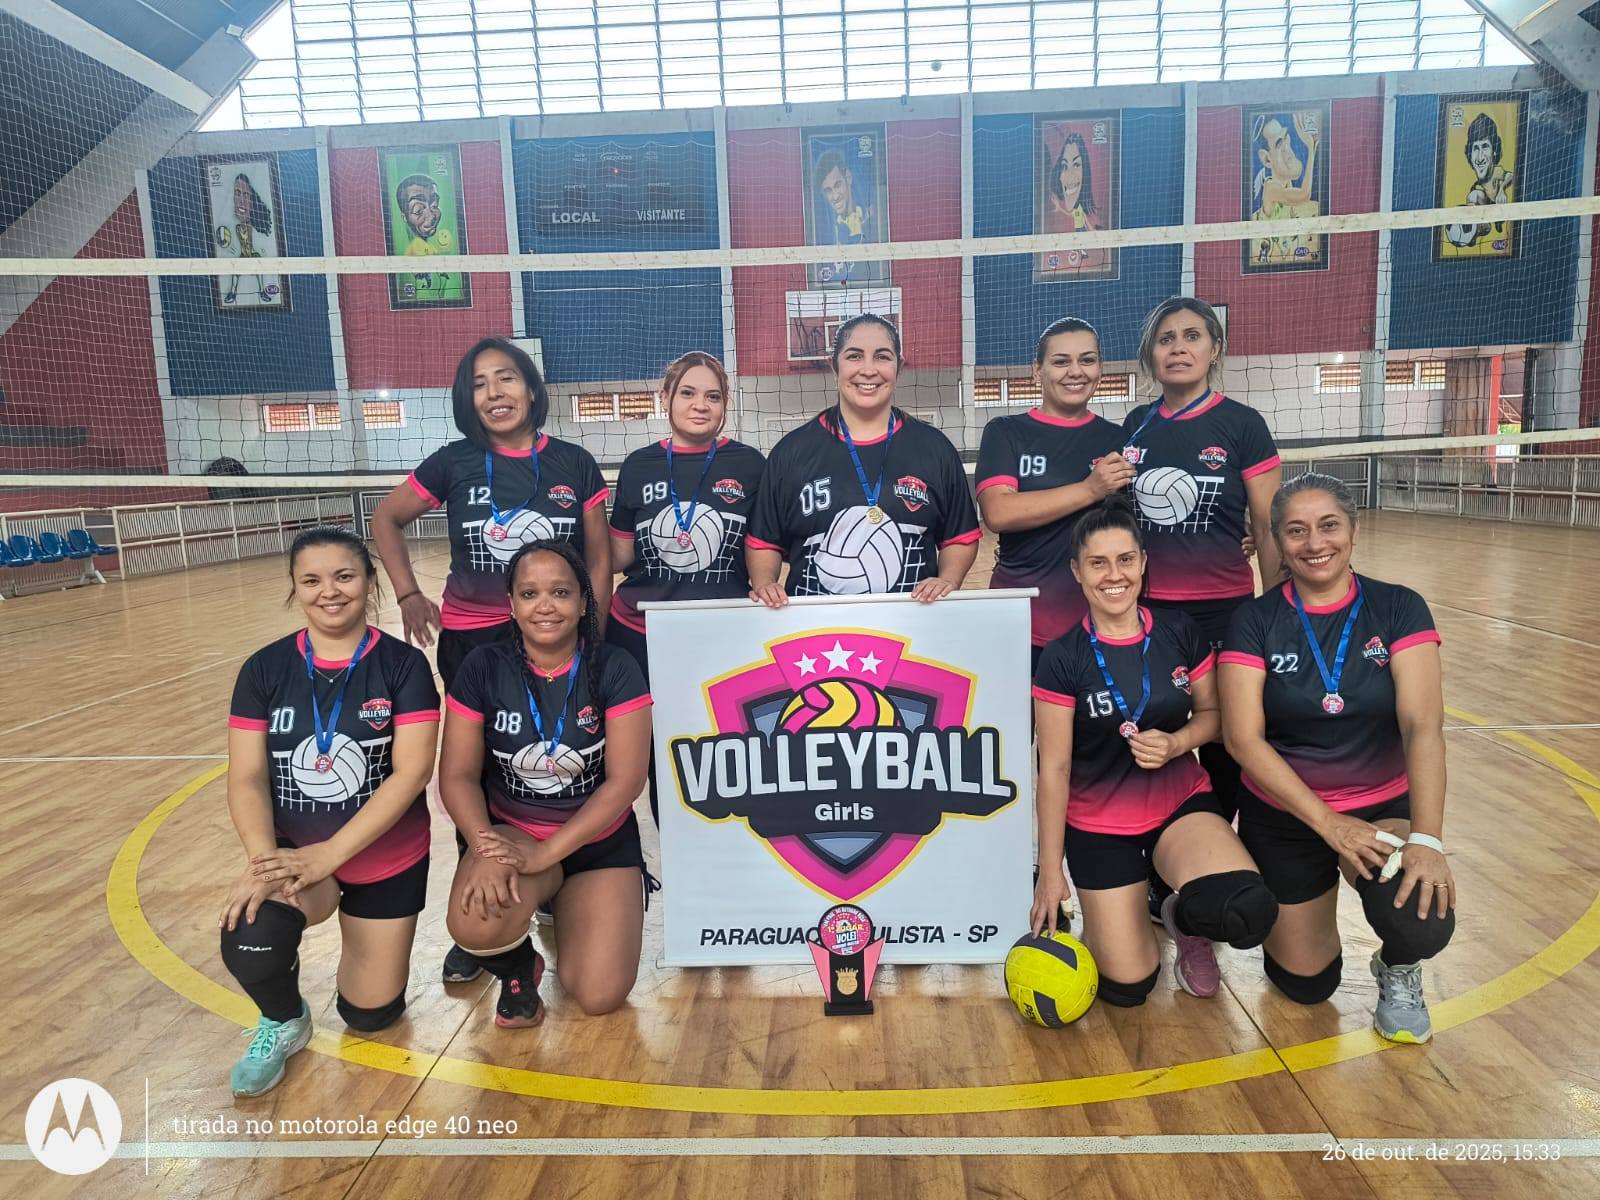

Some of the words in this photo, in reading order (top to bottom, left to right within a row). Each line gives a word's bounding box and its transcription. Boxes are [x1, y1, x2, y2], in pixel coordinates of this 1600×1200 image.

[551, 211, 600, 223] LOCAL
[636, 209, 686, 221] VISITANTE
[1019, 454, 1047, 477] 09
[467, 486, 491, 505] 12
[642, 481, 668, 505] 89
[712, 487, 746, 498] VOLLEYBALL
[800, 476, 832, 516] 05
[894, 485, 929, 503] VOLLEYBALL
[1271, 653, 1299, 673] 22
[359, 708, 391, 719] VOLLEYBA
[1086, 691, 1114, 718] 15
[269, 706, 294, 733] 10
[494, 710, 522, 734] 08
[677, 732, 1012, 801] VOLLEYBALL
[815, 803, 874, 821] Girls
[700, 927, 820, 945] PARAGUA
[873, 926, 945, 943] ULISTA
[968, 925, 998, 942] SP
